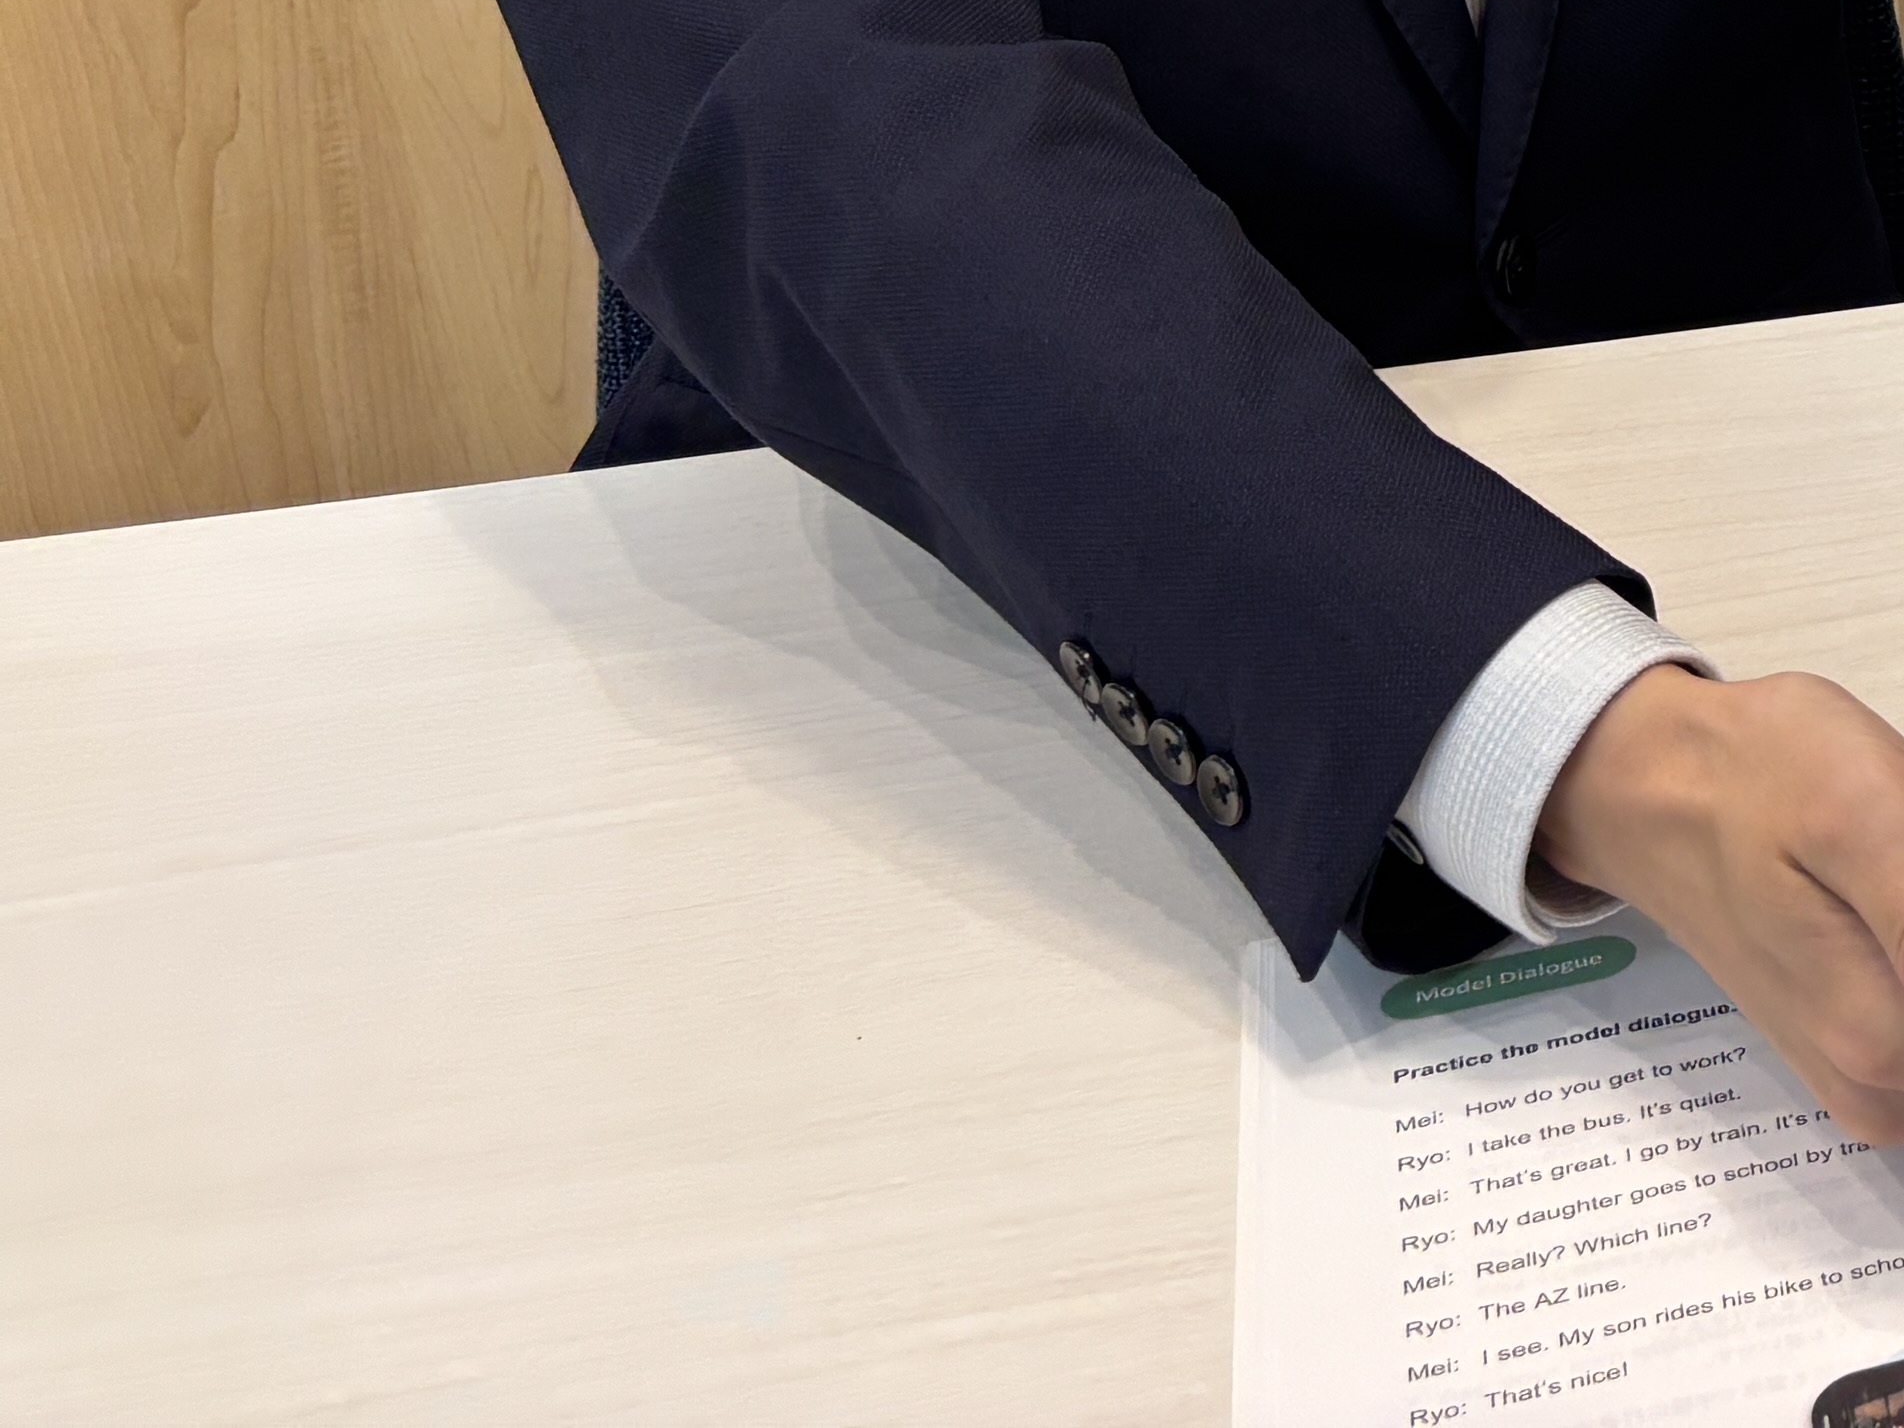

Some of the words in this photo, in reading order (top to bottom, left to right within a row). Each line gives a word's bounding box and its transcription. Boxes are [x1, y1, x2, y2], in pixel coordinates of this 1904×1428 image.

[1416, 974, 1492, 1003] Model
[1499, 955, 1602, 985] Dialogue
[1393, 1053, 1494, 1084] Practice
[1500, 1043, 1539, 1060] the
[1546, 1022, 1620, 1050] model
[1395, 1110, 1444, 1134] Mei:
[1465, 1096, 1517, 1118] How
[1524, 1089, 1553, 1105] do
[1560, 1079, 1601, 1101] you
[1608, 1068, 1645, 1090] get
[1652, 1065, 1673, 1078] to
[1678, 1047, 1746, 1072] work?
[1398, 1150, 1451, 1172] Ryo:
[1481, 1133, 1531, 1153] take
[1539, 1123, 1575, 1141] the
[1583, 1113, 1631, 1131] bus.
[1640, 1102, 1672, 1120] It's
[1679, 1088, 1741, 1113] quiet.
[1399, 1189, 1449, 1212] Mei:
[1469, 1169, 1543, 1195] That's
[1550, 1153, 1617, 1181] great.
[1640, 1143, 1669, 1162] go
[1676, 1136, 1703, 1152] by
[1710, 1123, 1767, 1144] train.
[1776, 1114, 1808, 1131] It's
[1402, 1230, 1455, 1253] Ryo:
[1473, 1218, 1508, 1237] My
[1516, 1193, 1623, 1226] daughter
[1630, 1180, 1687, 1205] goes
[1694, 1174, 1716, 1188] to
[1723, 1153, 1799, 1182] school
[1806, 1147, 1833, 1164] by
[1403, 1270, 1454, 1296] Mei:
[1476, 1245, 1566, 1279] Really?
[1573, 1228, 1649, 1256] Which
[1657, 1213, 1712, 1238] line?
[1405, 1314, 1461, 1338] Ryo:
[1478, 1301, 1526, 1321] The
[1534, 1287, 1570, 1310] AZ
[1577, 1279, 1626, 1299] line.
[1408, 1358, 1459, 1383] Mei:
[1497, 1341, 1549, 1361] see.
[1559, 1328, 1595, 1348] My
[1603, 1317, 1647, 1337] son
[1655, 1301, 1714, 1325] rides
[1722, 1290, 1756, 1310] his
[1764, 1278, 1813, 1300] bike
[1820, 1272, 1843, 1287] to
[1410, 1403, 1467, 1428] Ryo:
[1483, 1379, 1562, 1408] That's
